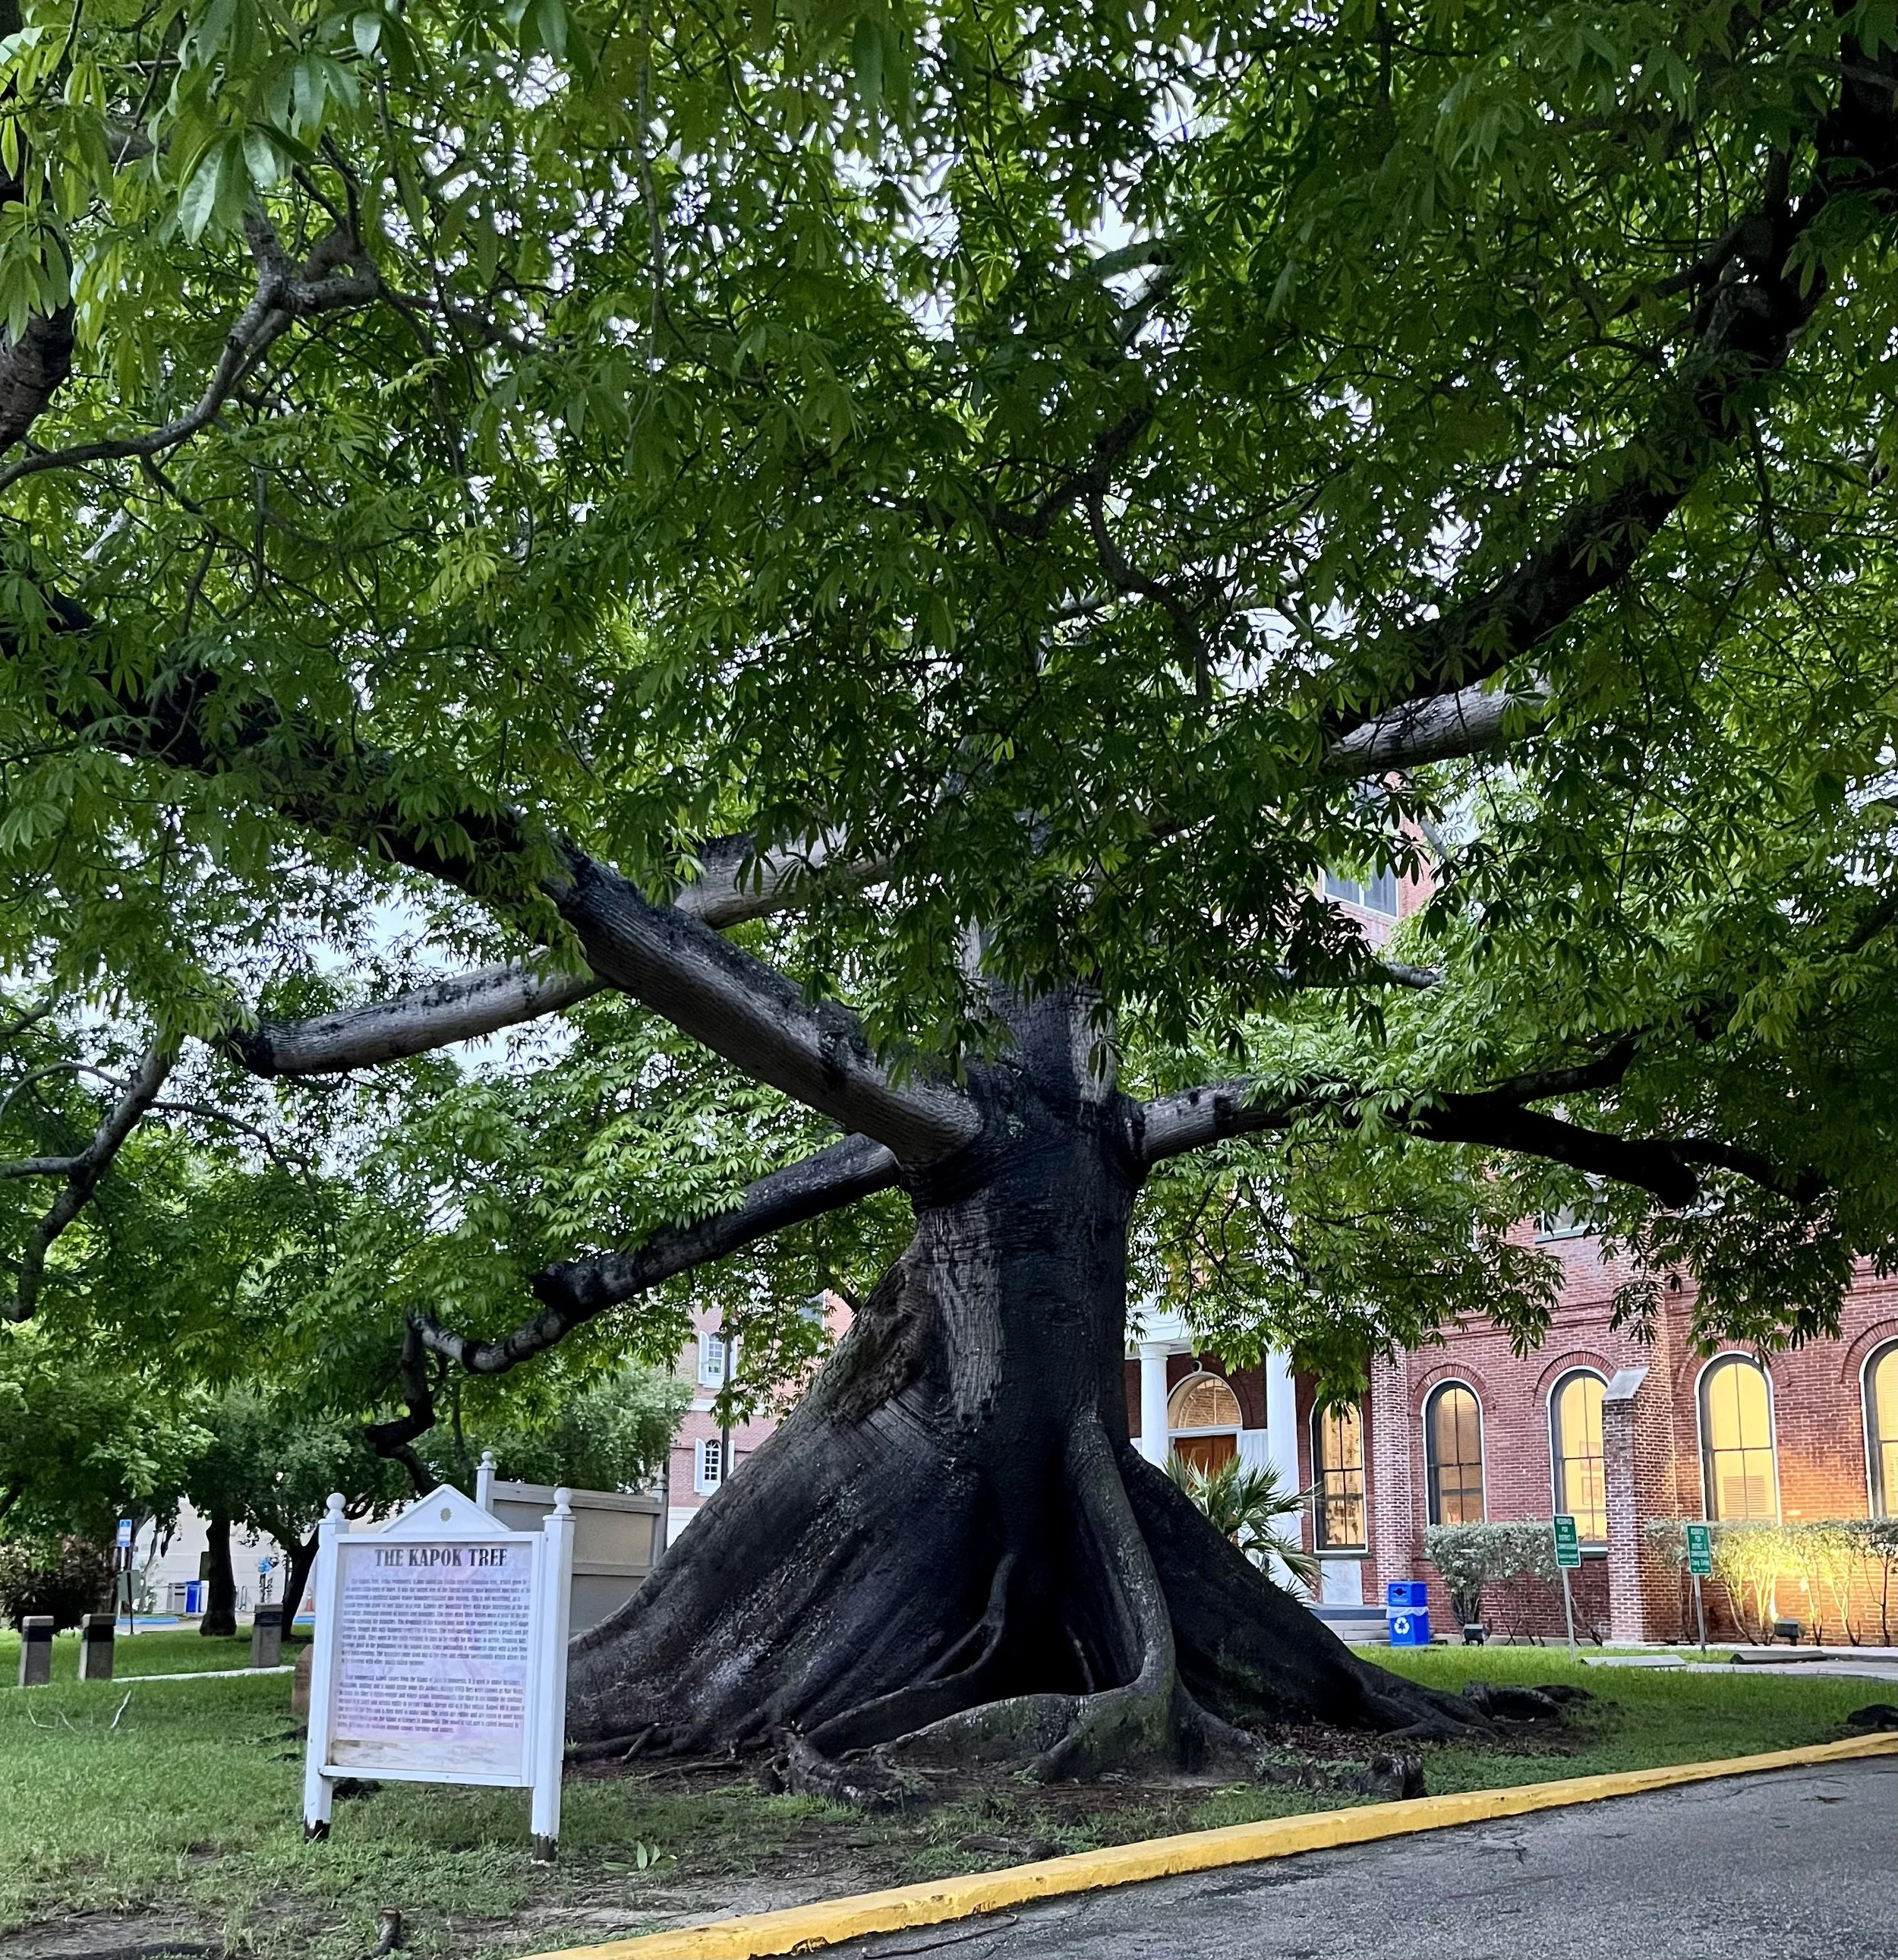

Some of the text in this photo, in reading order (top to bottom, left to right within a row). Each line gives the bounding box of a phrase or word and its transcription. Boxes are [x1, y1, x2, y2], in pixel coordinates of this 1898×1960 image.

[375, 1548, 507, 1567] THE KAPOK TREE
